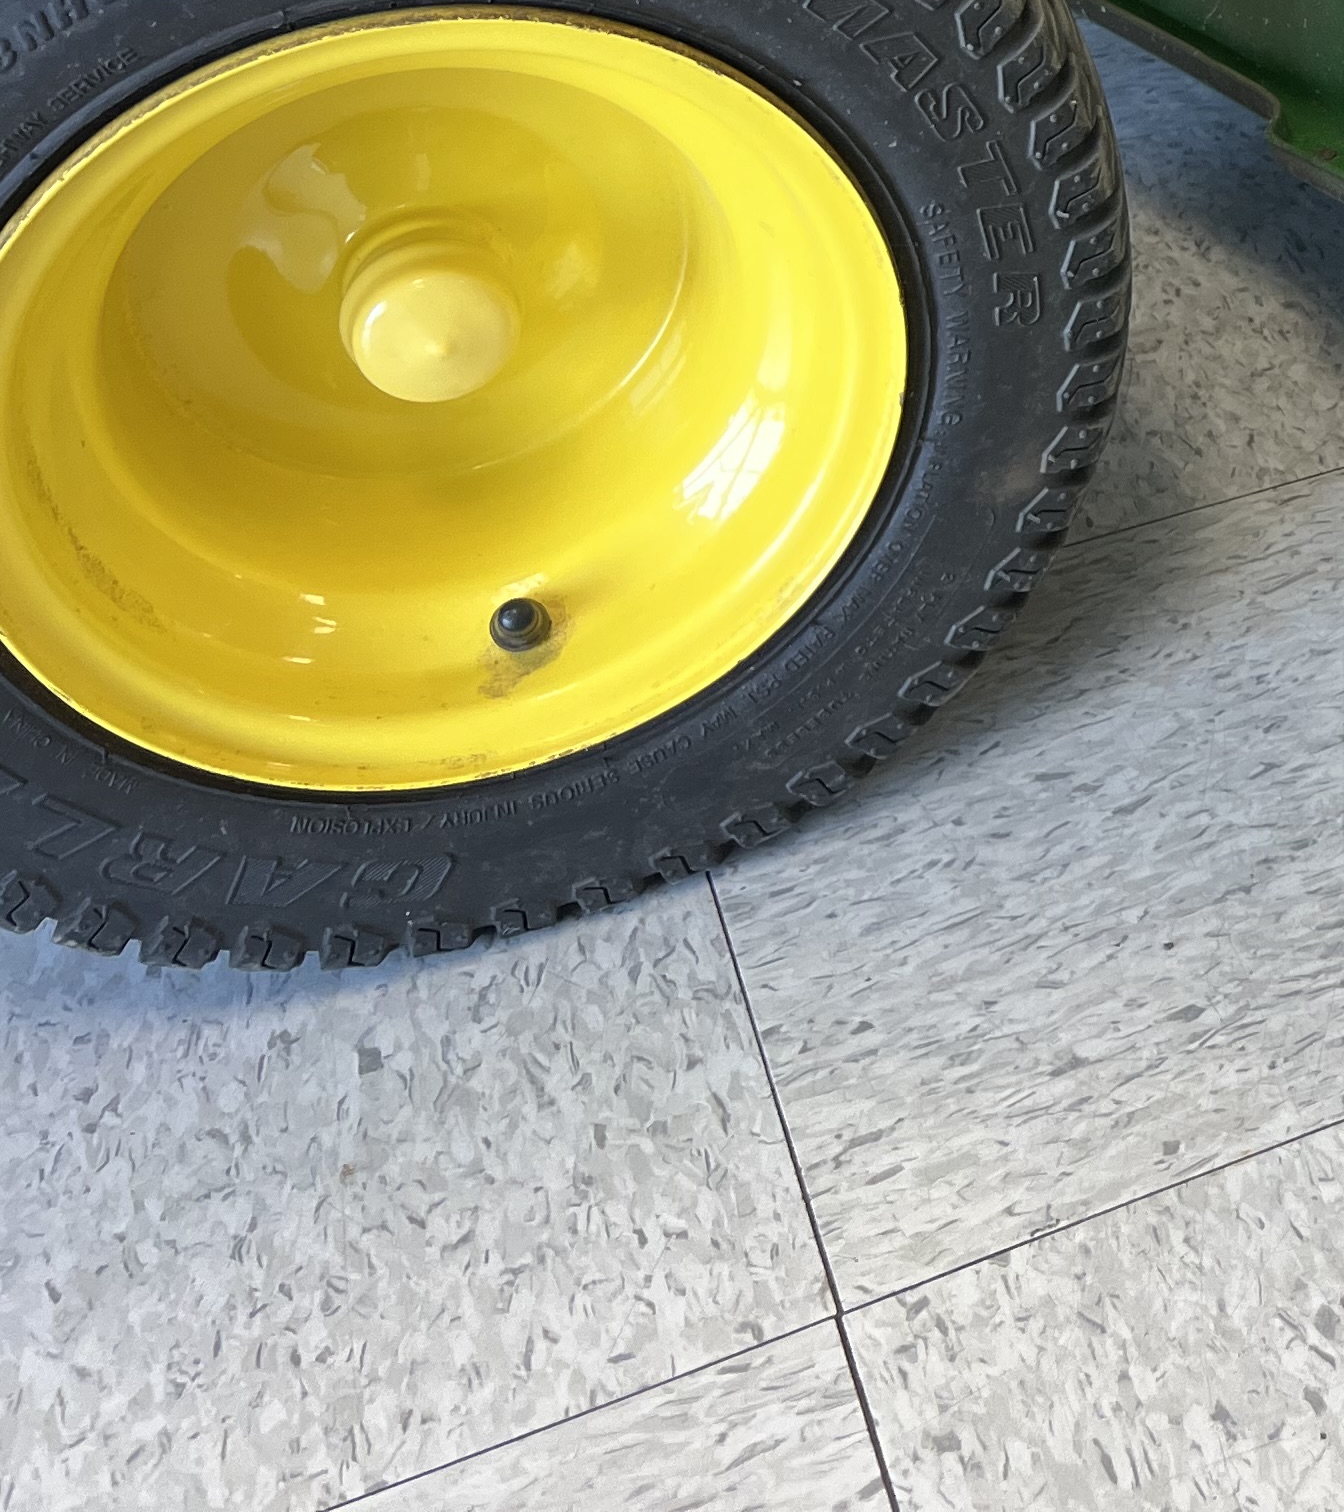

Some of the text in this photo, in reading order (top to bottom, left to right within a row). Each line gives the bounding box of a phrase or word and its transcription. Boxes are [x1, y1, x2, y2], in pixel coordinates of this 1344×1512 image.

[918, 200, 968, 297] SAFETY
[694, 705, 741, 739] MAY
[623, 732, 696, 777] CAUSE
[286, 814, 413, 836] EXPLOSION
